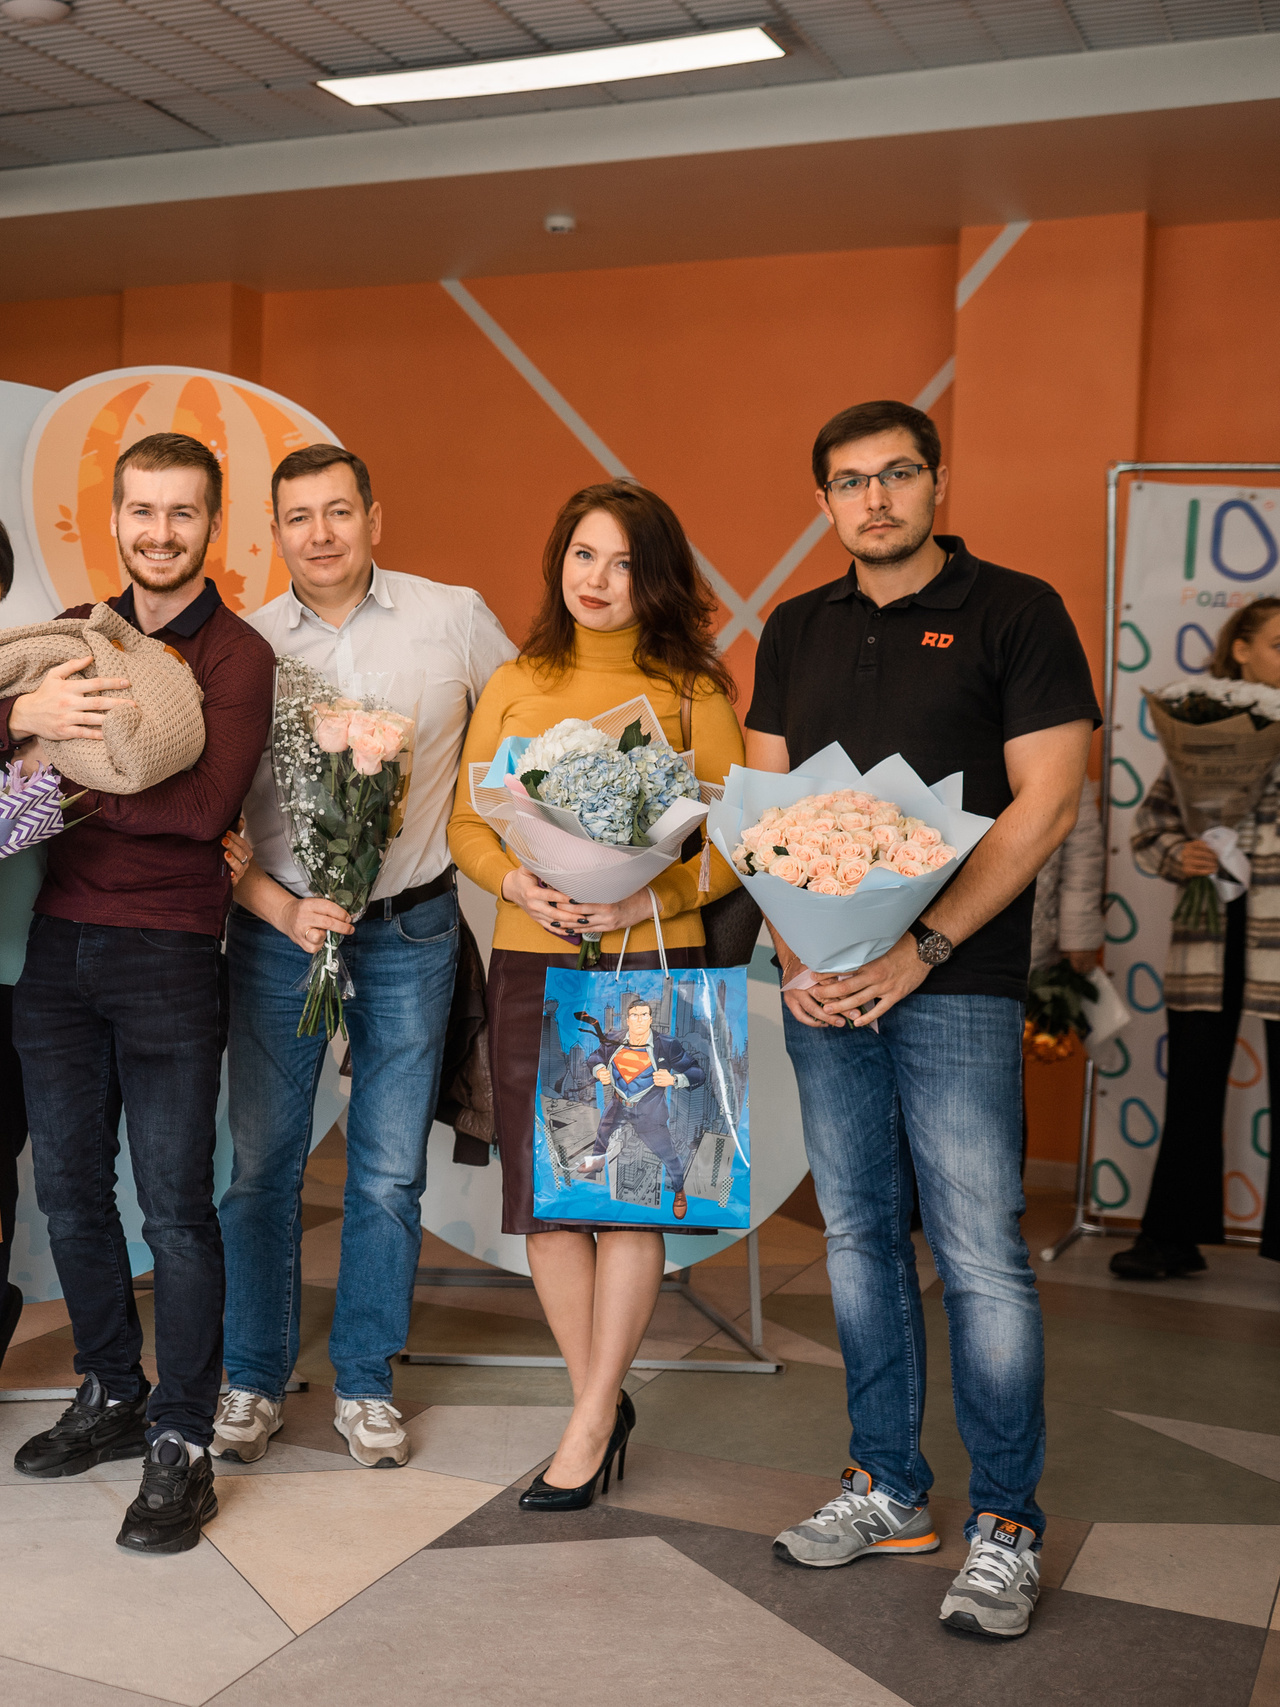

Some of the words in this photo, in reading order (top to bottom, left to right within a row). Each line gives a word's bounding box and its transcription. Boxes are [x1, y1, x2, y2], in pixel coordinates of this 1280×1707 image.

[1184, 499, 1279, 582] 10
[921, 631, 954, 649] RD
[995, 1530, 1015, 1545] 574
